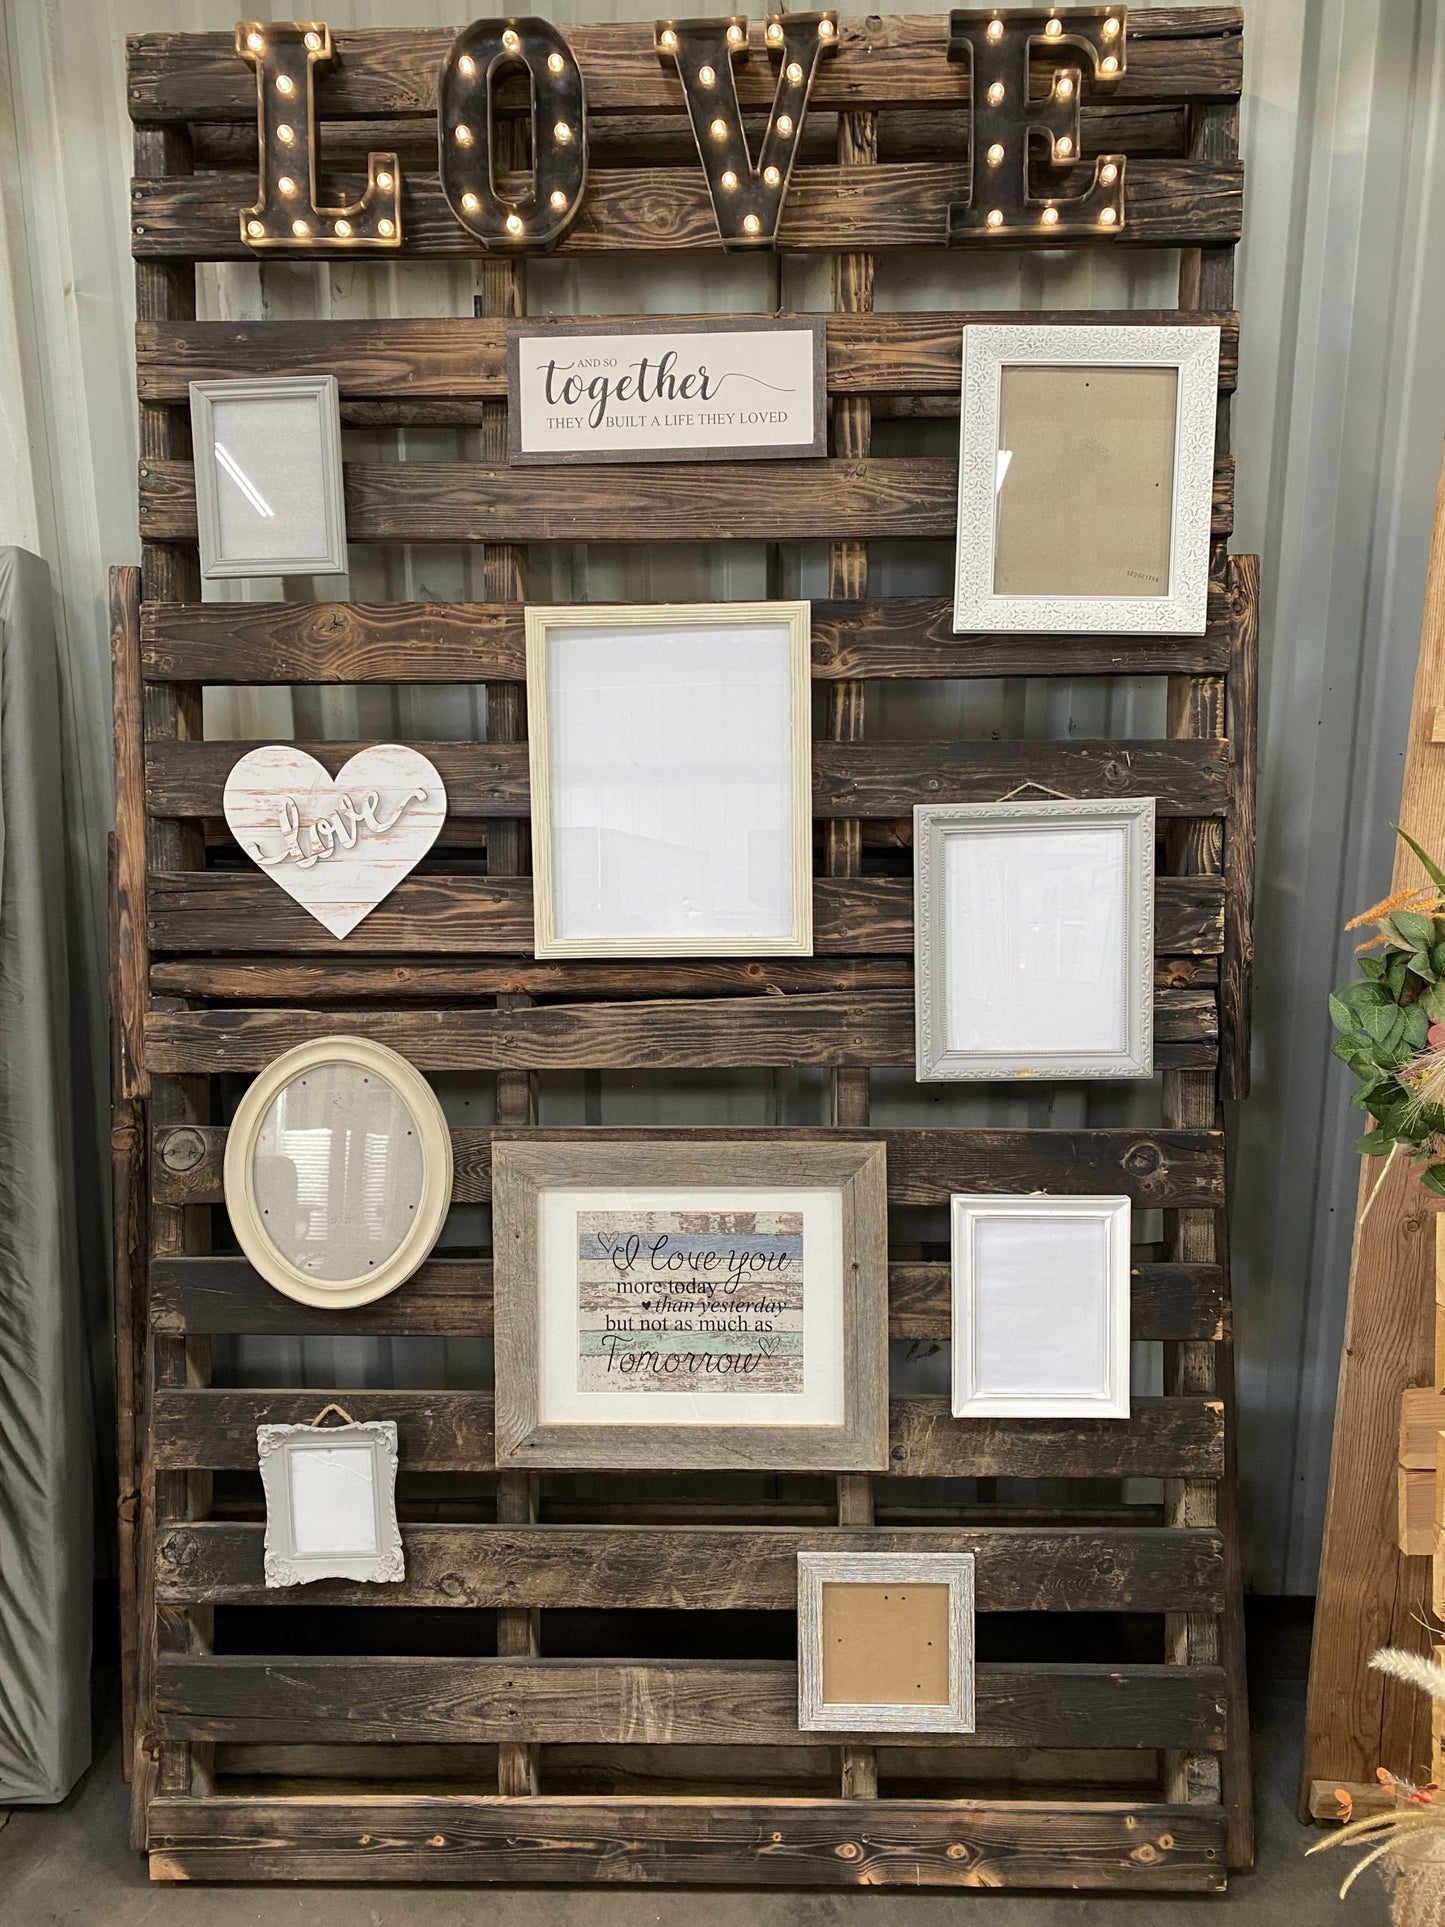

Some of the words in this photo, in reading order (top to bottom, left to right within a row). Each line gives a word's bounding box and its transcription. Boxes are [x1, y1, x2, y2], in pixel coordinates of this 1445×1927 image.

[236, 4, 1127, 248] LOVE
[577, 358, 601, 368] AND
[603, 358, 617, 368] SO
[537, 351, 796, 429] together
[547, 416, 584, 429] THEY
[606, 415, 647, 428] BUILT
[650, 415, 661, 427] A
[665, 414, 695, 427] LIFE
[698, 413, 736, 426] THEY
[739, 411, 788, 424] LOVED
[612, 1235, 640, 1271] I
[724, 1249, 792, 1294] you
[617, 1282, 662, 1294] more
[668, 1278, 718, 1298] today
[655, 1297, 694, 1313] than
[698, 1297, 787, 1317] yesterday
[606, 1315, 634, 1332] but
[640, 1318, 668, 1332] not
[674, 1320, 693, 1332] as
[699, 1315, 748, 1332] much
[754, 1320, 773, 1332] as
[601, 1335, 763, 1373] Tomorrow
